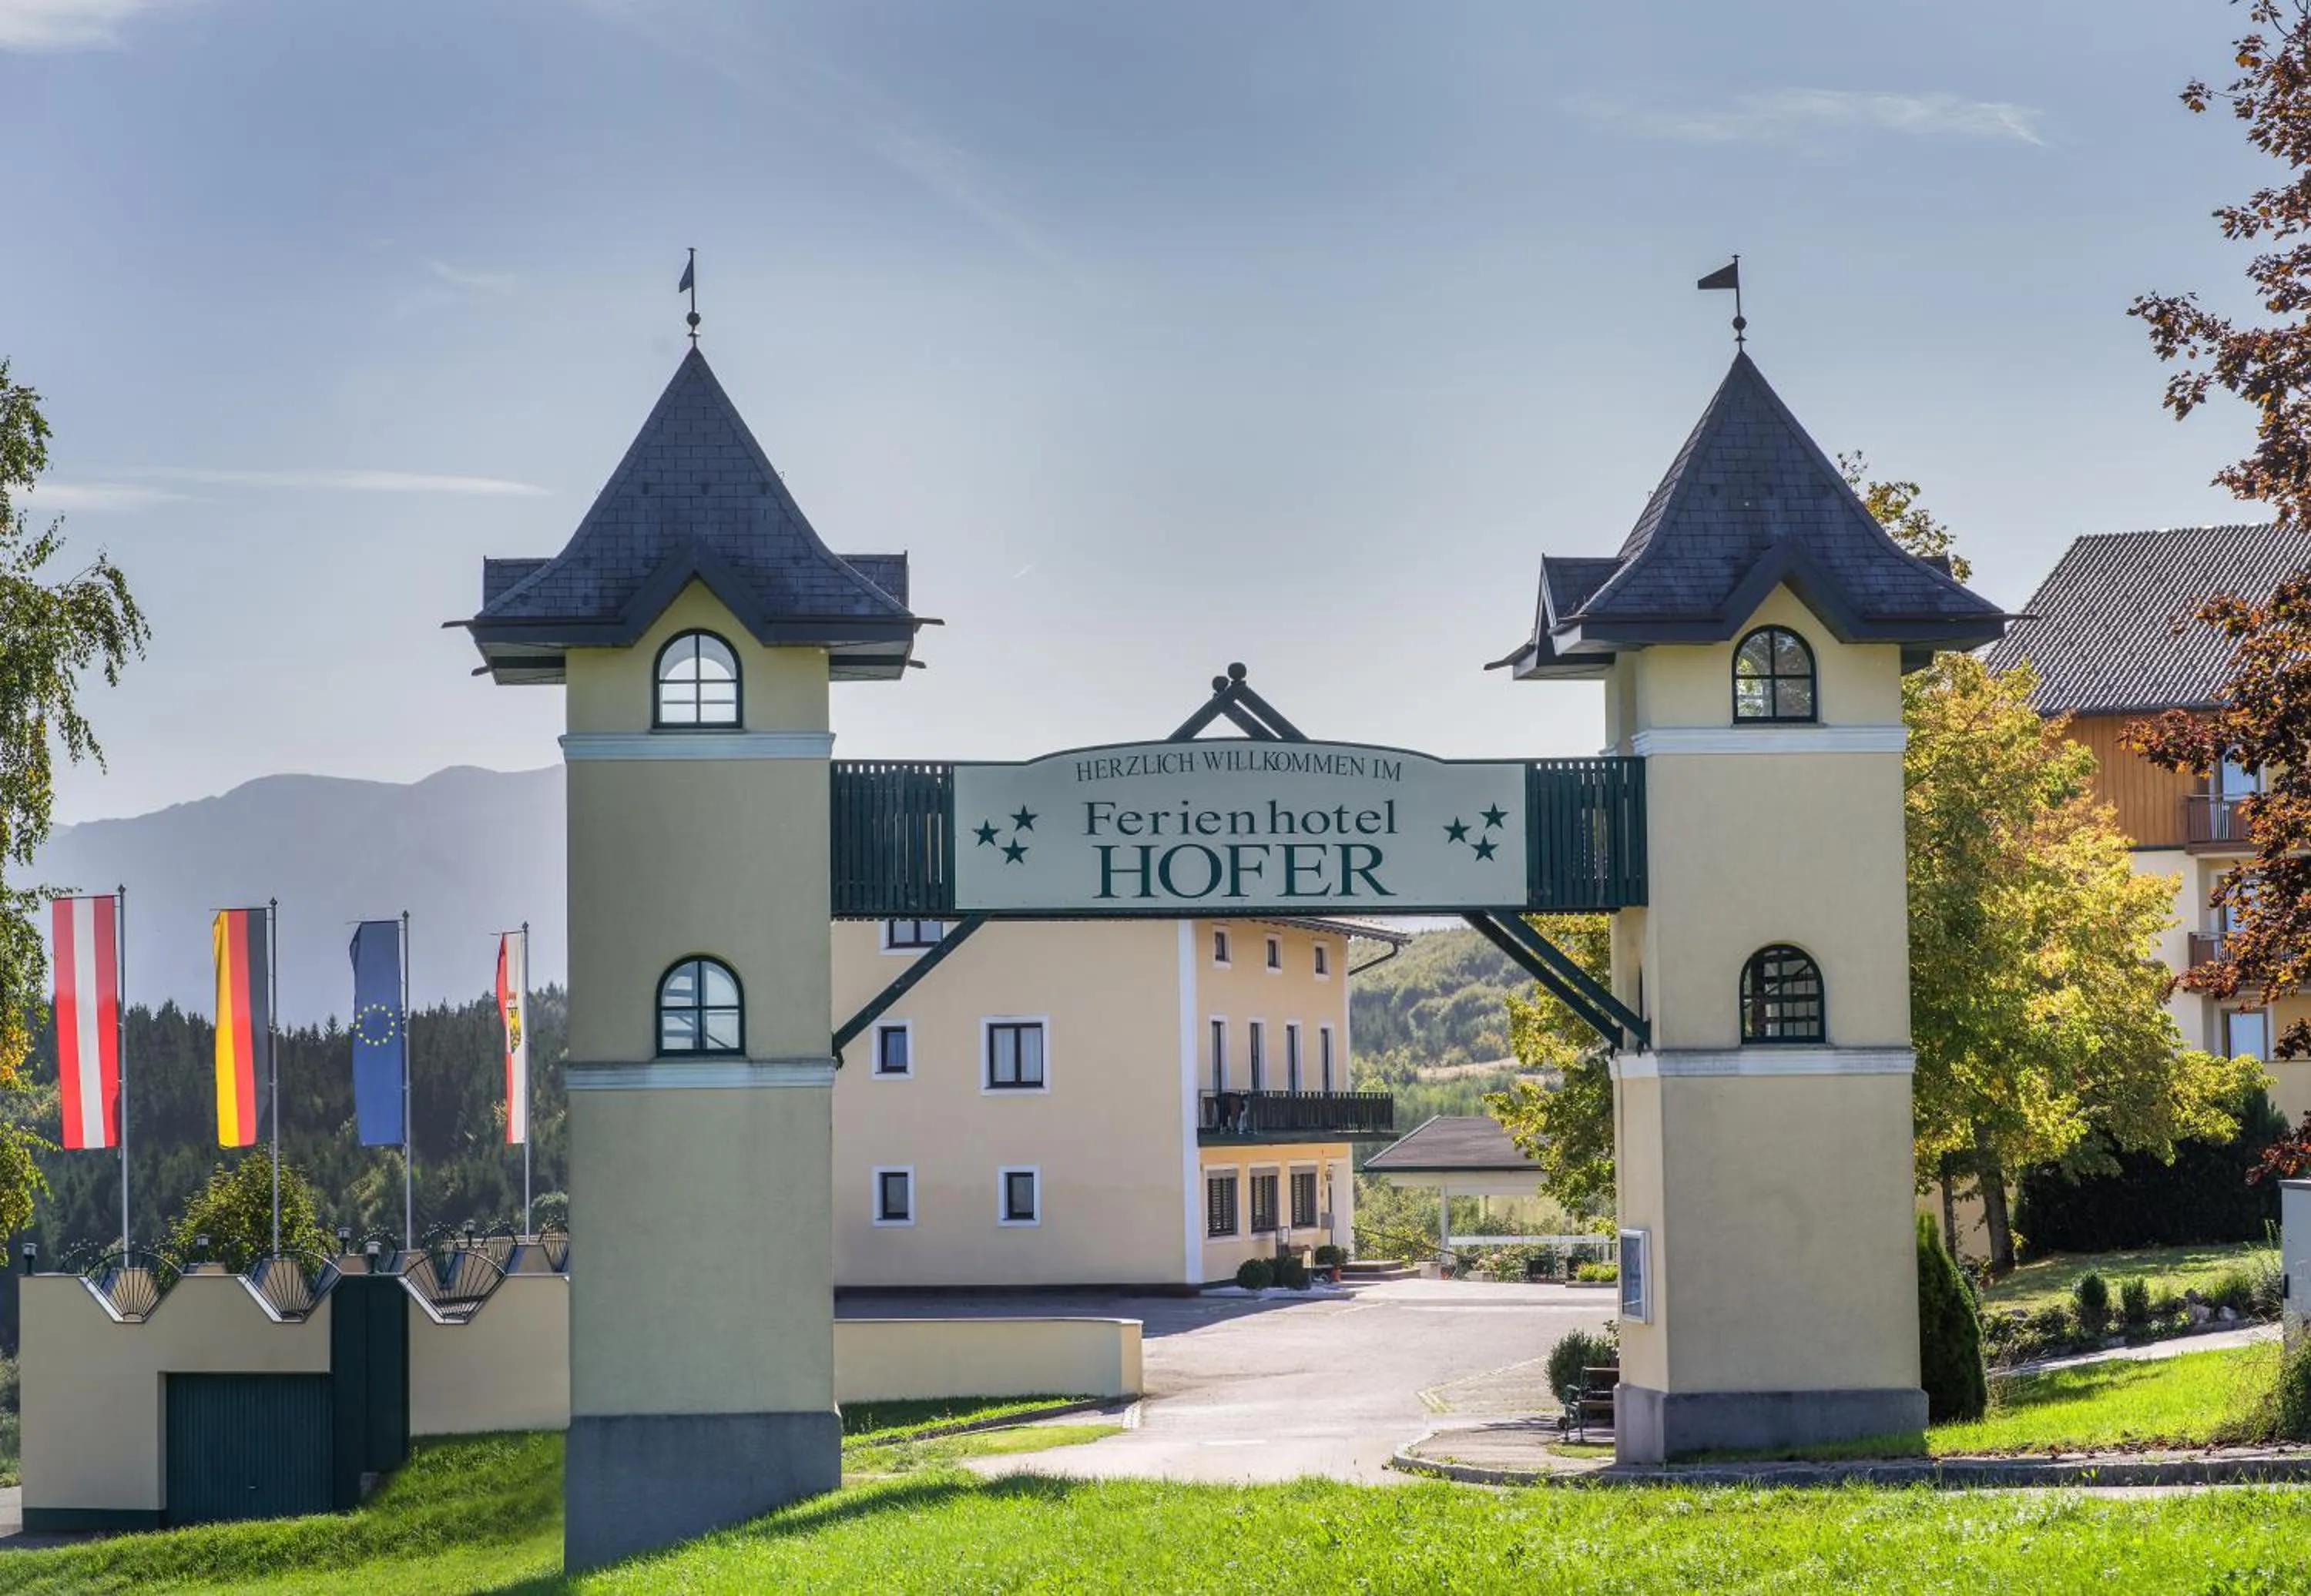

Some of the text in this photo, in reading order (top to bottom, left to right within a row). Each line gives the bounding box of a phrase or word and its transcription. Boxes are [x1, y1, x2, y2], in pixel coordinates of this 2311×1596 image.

[1075, 751, 1401, 782] HERZLICH WILLKOMMEN IM
[1082, 800, 1398, 836] Ferienhotel
[1092, 843, 1397, 899] HOFER
